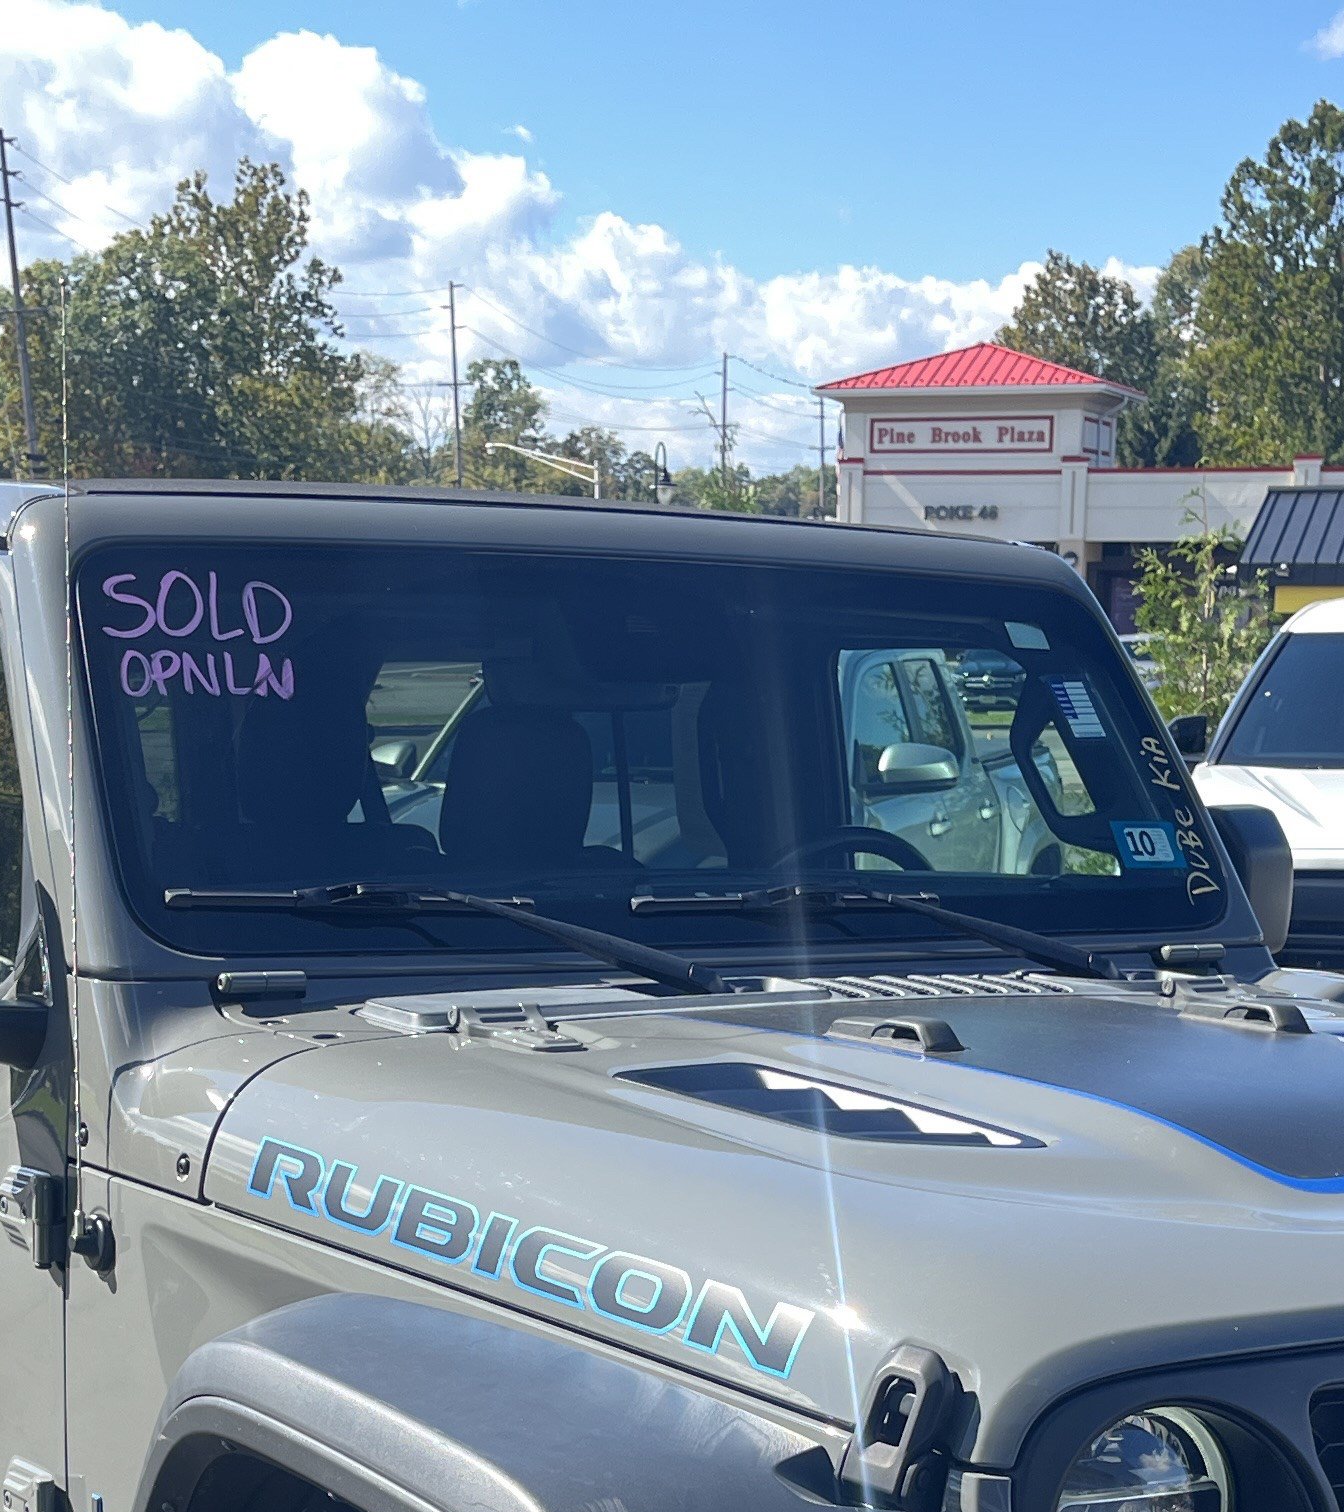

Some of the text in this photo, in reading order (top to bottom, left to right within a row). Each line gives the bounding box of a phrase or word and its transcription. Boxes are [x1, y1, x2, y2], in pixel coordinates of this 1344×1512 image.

[877, 425, 1046, 444] Pine Brook Plaza
[102, 569, 292, 644] SOLD
[120, 649, 295, 700] OPNLN
[1125, 830, 1156, 857] 10
[247, 1135, 815, 1379] RUBICON
